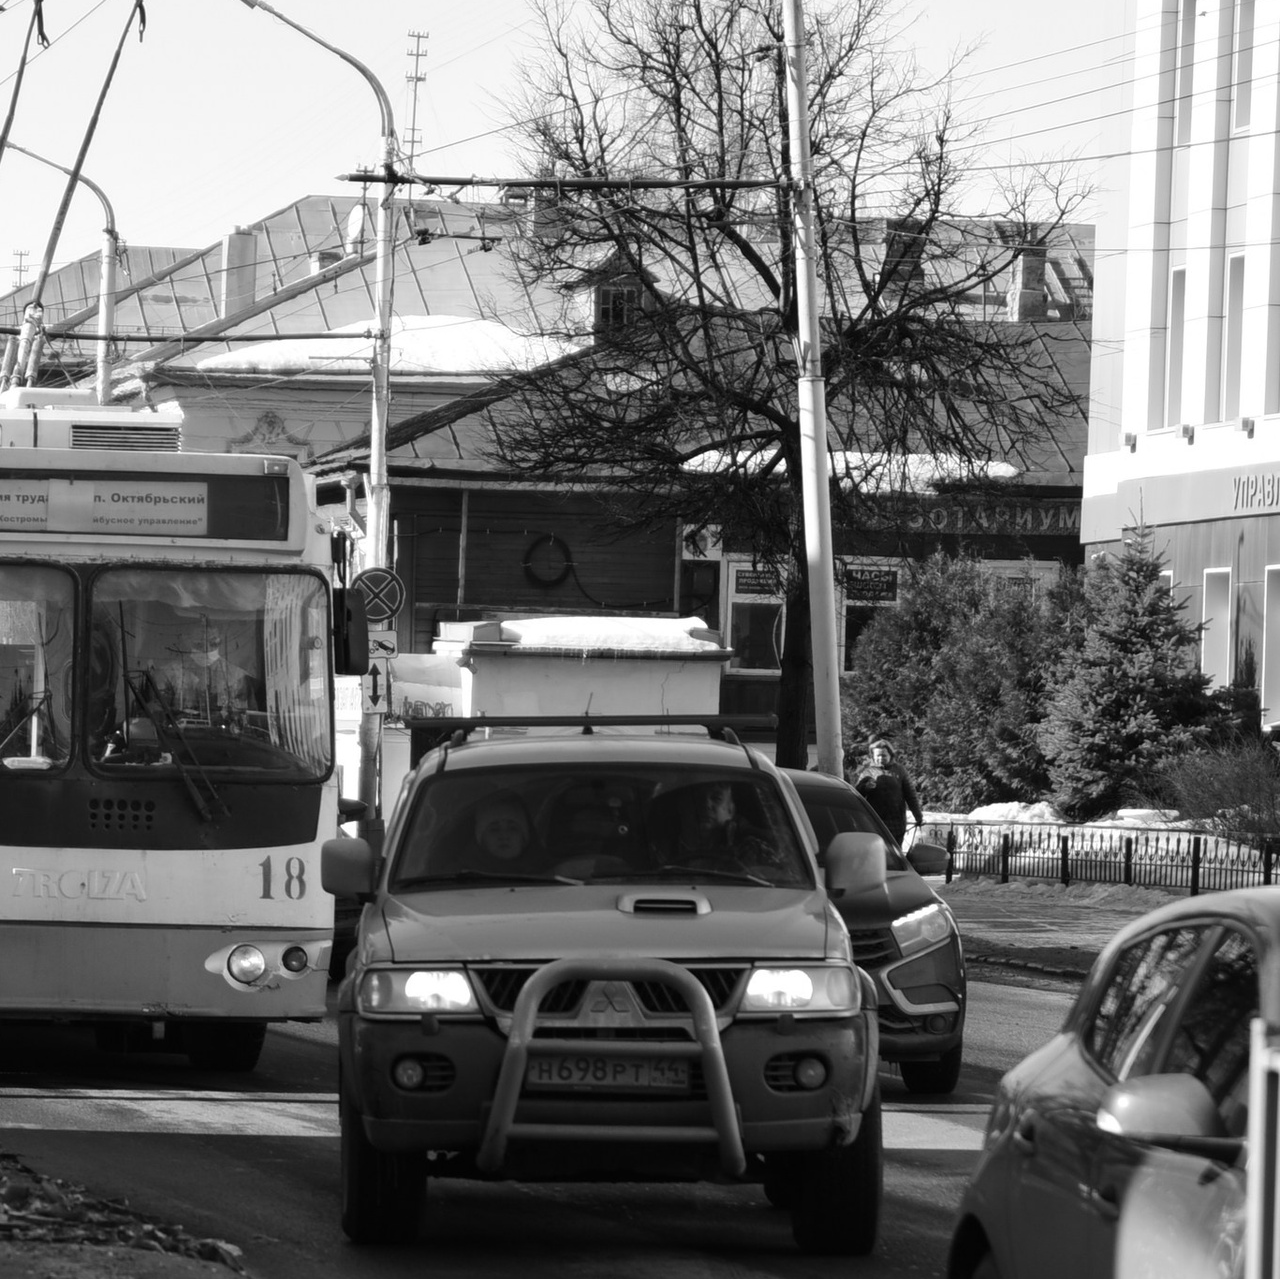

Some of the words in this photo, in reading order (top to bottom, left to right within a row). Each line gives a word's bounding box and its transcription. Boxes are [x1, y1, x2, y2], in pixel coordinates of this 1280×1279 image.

[93, 494, 106, 503] п.
[111, 492, 205, 506] Октябрьский
[852, 570, 893, 582] ЧАСЫ
[258, 855, 307, 900] 18
